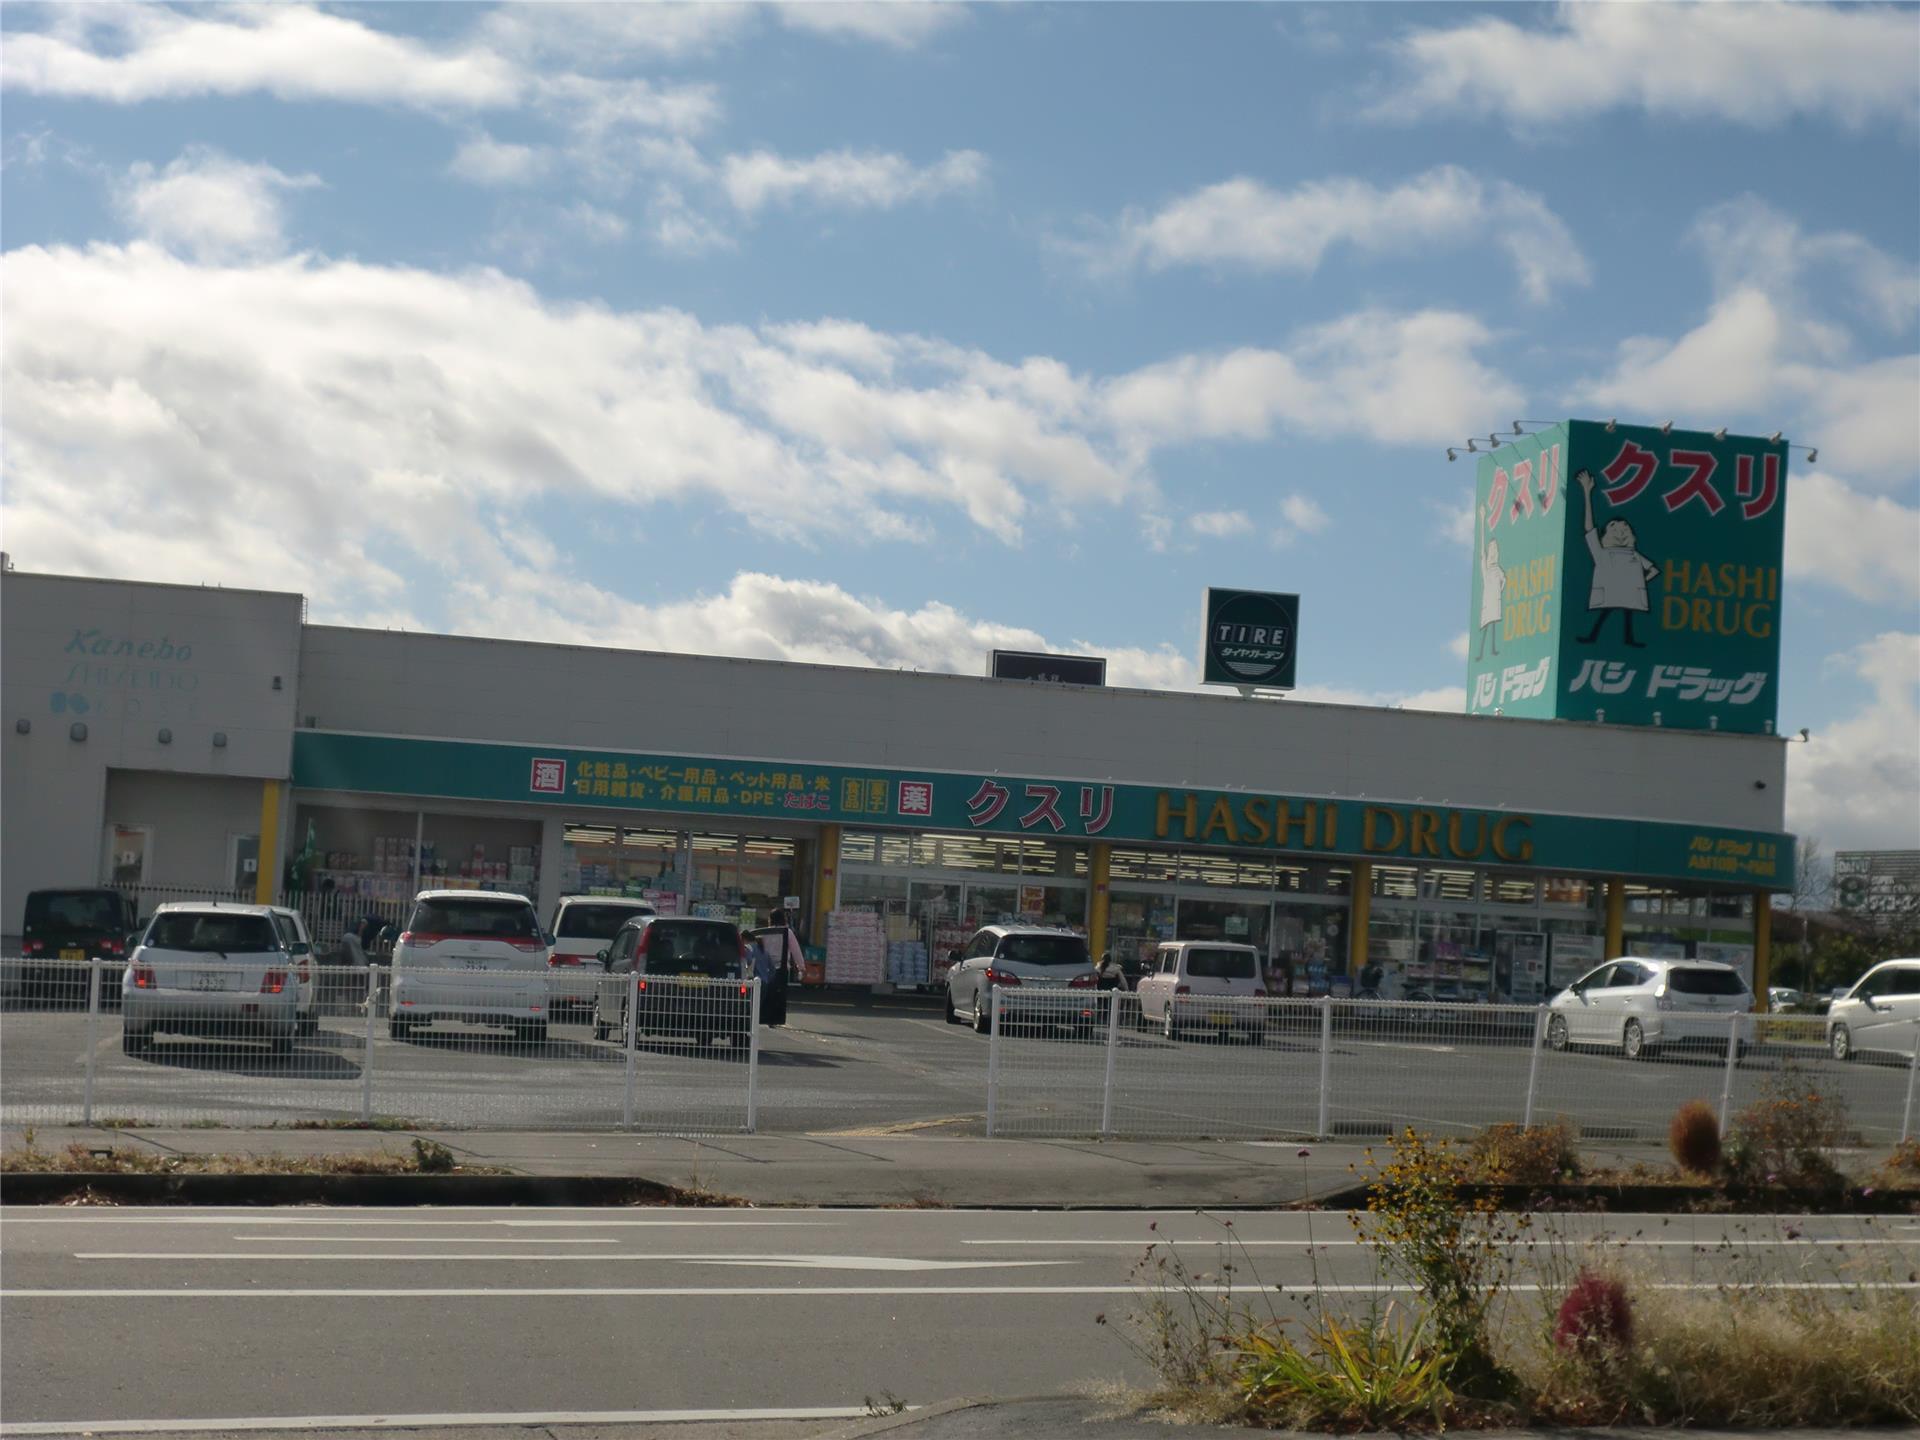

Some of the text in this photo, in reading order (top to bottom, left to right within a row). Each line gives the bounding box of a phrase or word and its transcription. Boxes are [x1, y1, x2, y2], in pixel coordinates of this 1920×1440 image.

[1487, 443, 1560, 530] クスリ
[1601, 439, 1780, 520] クスリ
[1505, 555, 1555, 602] HASHI
[1663, 560, 1777, 601] HASHI
[1219, 625, 1285, 645] TIRE
[1504, 594, 1552, 641] DRUG
[1662, 596, 1772, 639] DRUG
[64, 629, 193, 662] Kanebo
[1472, 656, 1551, 710] ハシ ドラッグ
[1569, 659, 1768, 705] ハシ ドラッグ
[535, 762, 561, 790] 酒
[902, 784, 929, 812] 薬
[966, 778, 1115, 835] クスリ
[1157, 792, 1535, 862] HASHI DRUG
